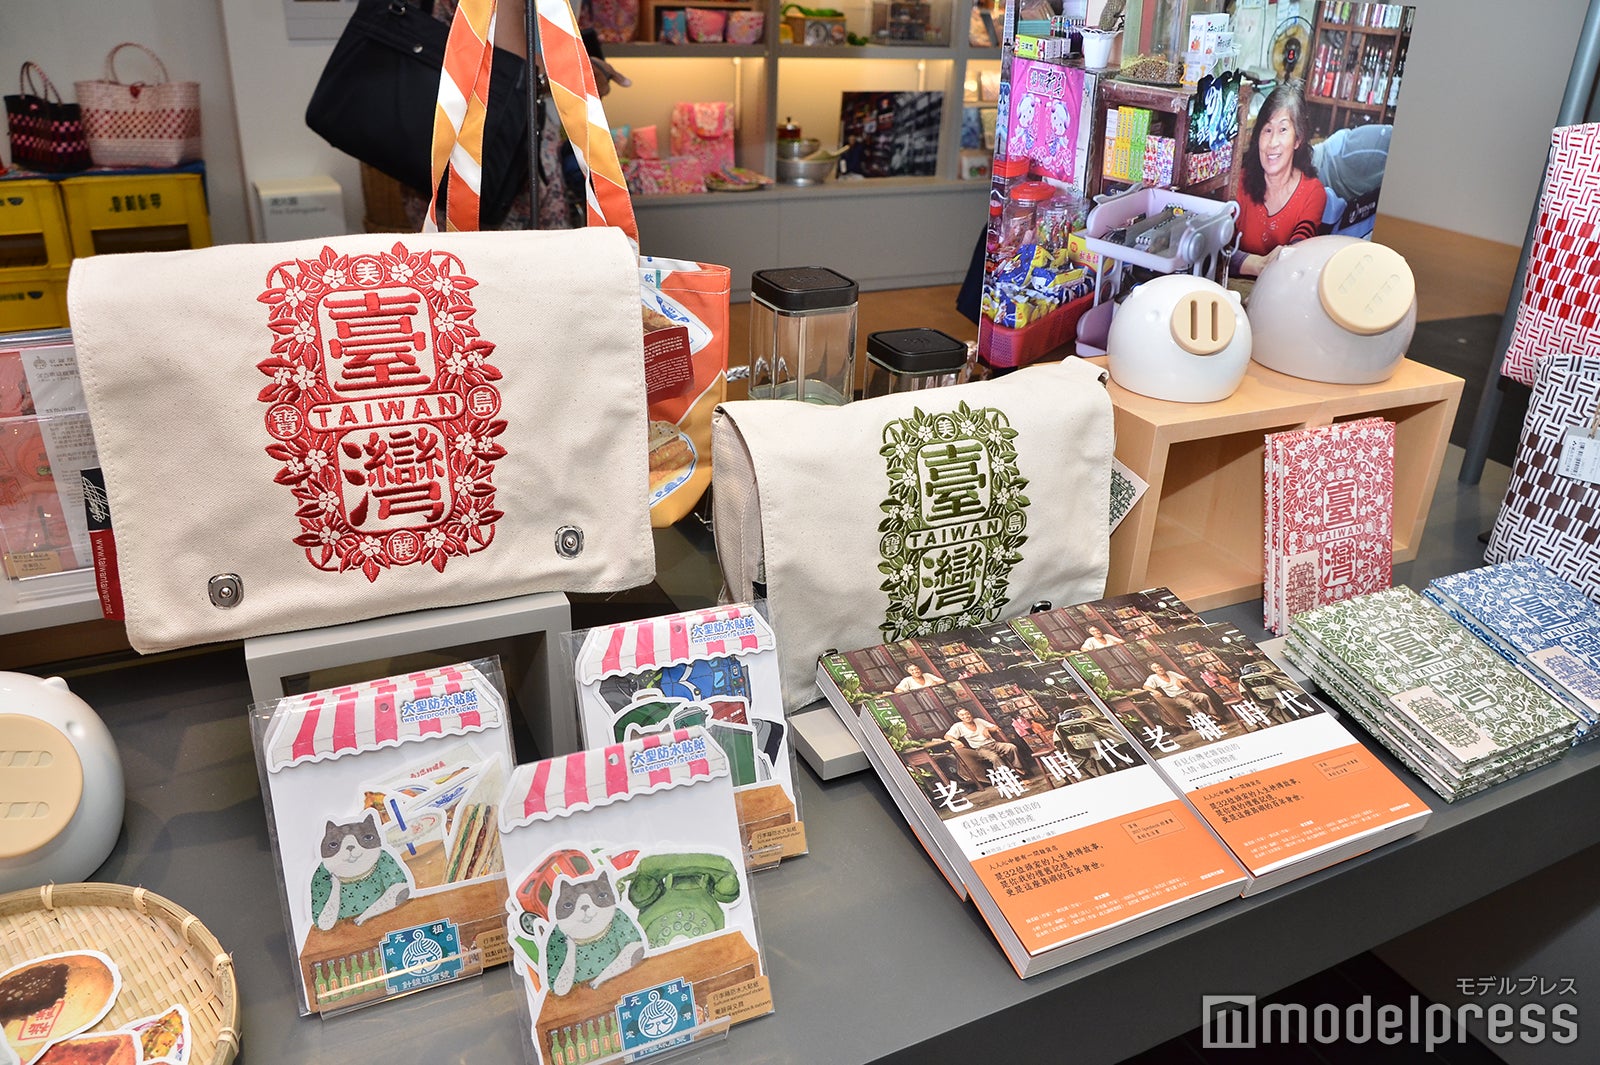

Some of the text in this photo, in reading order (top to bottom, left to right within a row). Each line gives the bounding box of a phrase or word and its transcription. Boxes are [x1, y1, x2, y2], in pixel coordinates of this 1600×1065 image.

[355, 262, 380, 284] 美
[323, 291, 431, 392] 臺
[312, 396, 457, 428] TAIWAN
[472, 391, 494, 413] 島
[341, 427, 445, 527] 灣
[920, 442, 987, 522] 臺
[1325, 481, 1355, 526] 臺
[909, 520, 999, 548] TAIWAN
[1319, 525, 1362, 541] TAIWAN
[1323, 539, 1353, 585] 灣
[917, 544, 983, 616] 灣
[693, 616, 755, 637] 大型防水貼紙
[694, 629, 756, 644] waterproof sticker
[1544, 622, 1588, 639] TAIWAN
[1411, 658, 1461, 679] TAIWAN
[403, 690, 478, 715] 大型防水貼紙
[403, 704, 479, 724] waterproof sticker
[1141, 689, 1315, 753] 老雜時代
[633, 737, 706, 766] 大型防水貼紙
[634, 751, 707, 775] waterproof sticker
[932, 738, 1135, 813] 老雜時代
[667, 984, 679, 995] 祖
